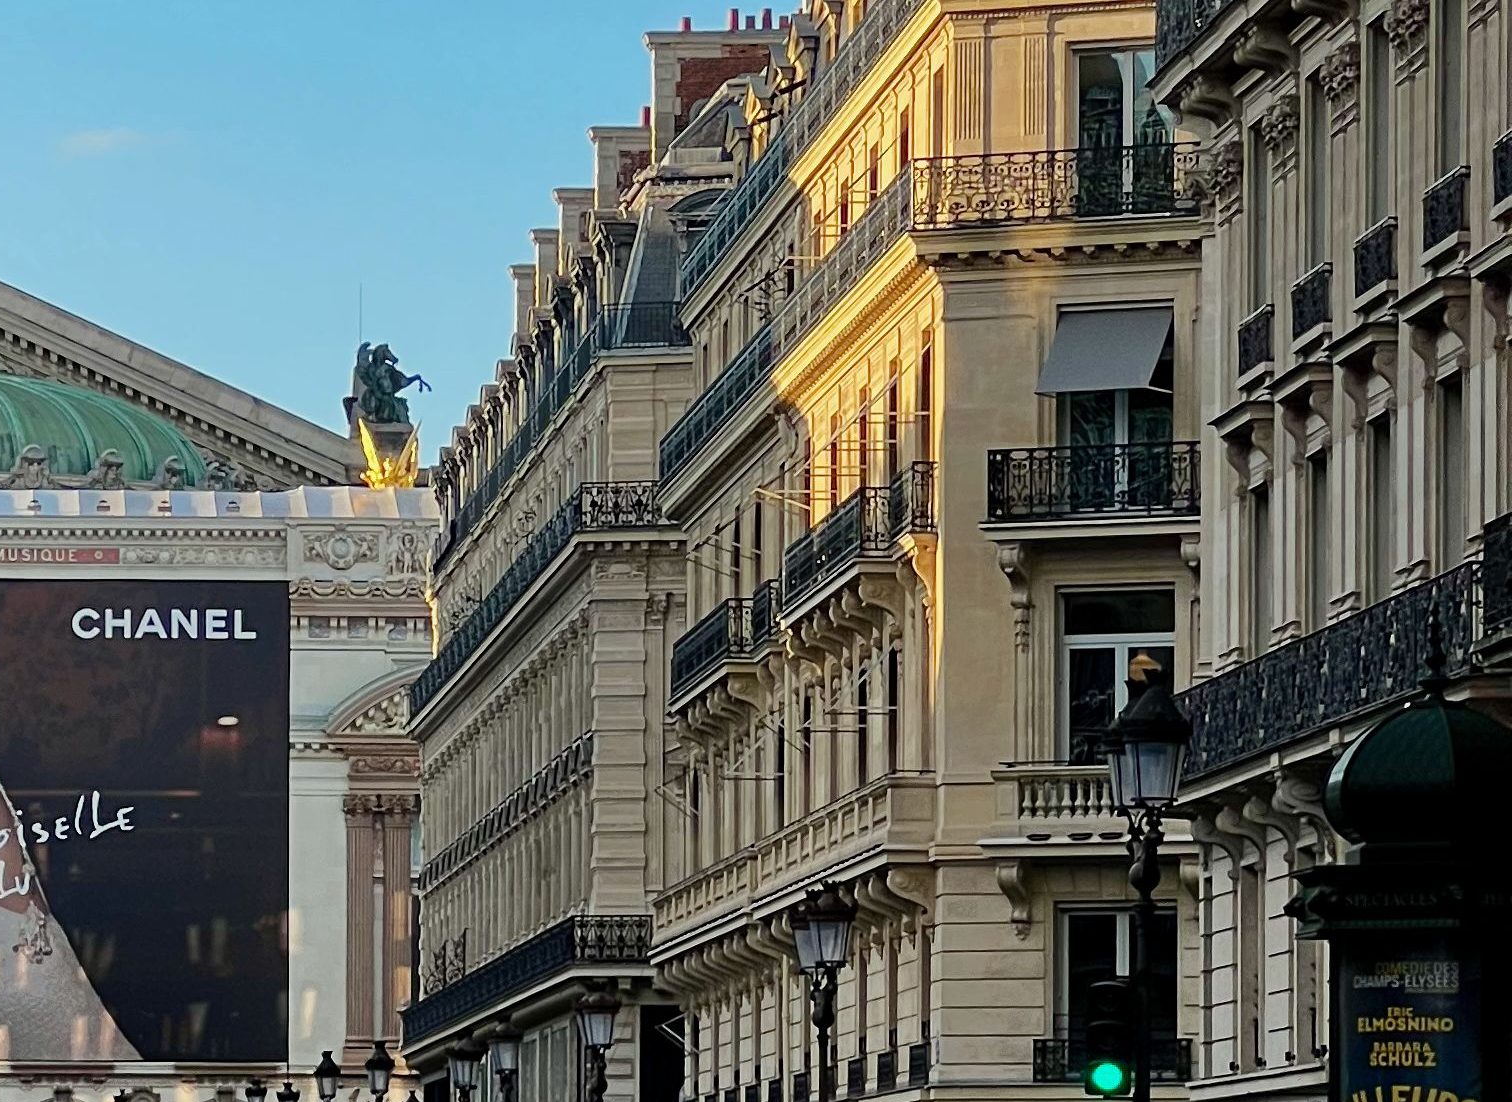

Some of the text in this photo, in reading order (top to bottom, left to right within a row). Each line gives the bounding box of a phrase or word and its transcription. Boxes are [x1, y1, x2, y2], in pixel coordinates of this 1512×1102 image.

[71, 607, 257, 640] CHANEL
[1358, 1017, 1453, 1032] ELMOSNINO
[1373, 1042, 1431, 1052] BARBARA
[1370, 1052, 1436, 1066] SCHULZ
